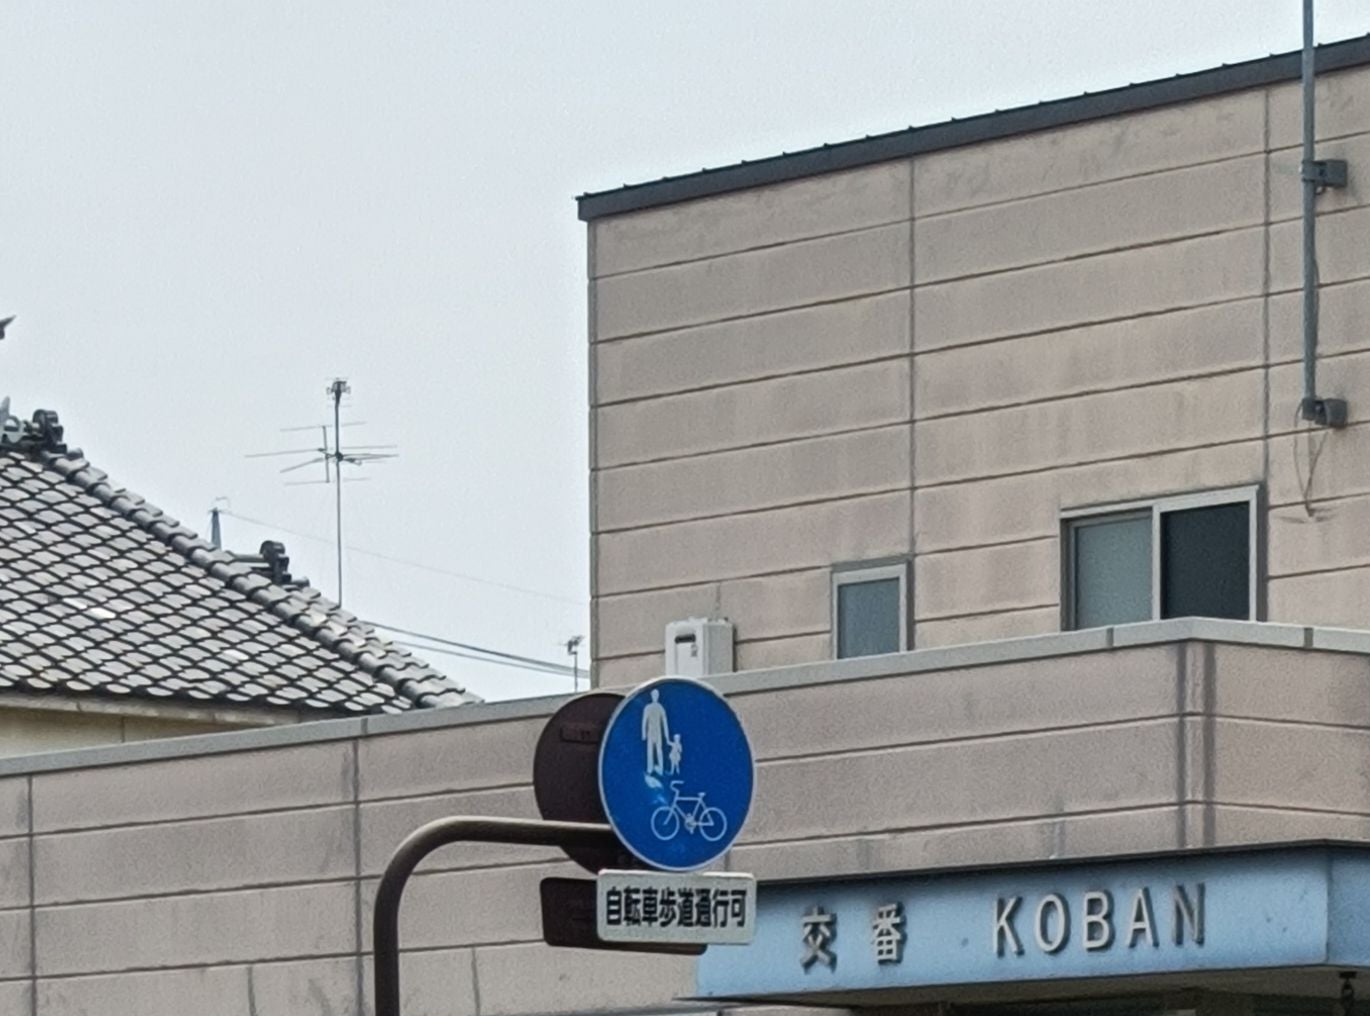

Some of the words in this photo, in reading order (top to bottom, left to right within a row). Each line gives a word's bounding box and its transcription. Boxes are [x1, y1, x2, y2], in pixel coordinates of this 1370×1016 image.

[606, 886, 747, 928] 自転車歩道通行可
[801, 903, 907, 974] 交番
[993, 882, 1206, 957] KOBAN
